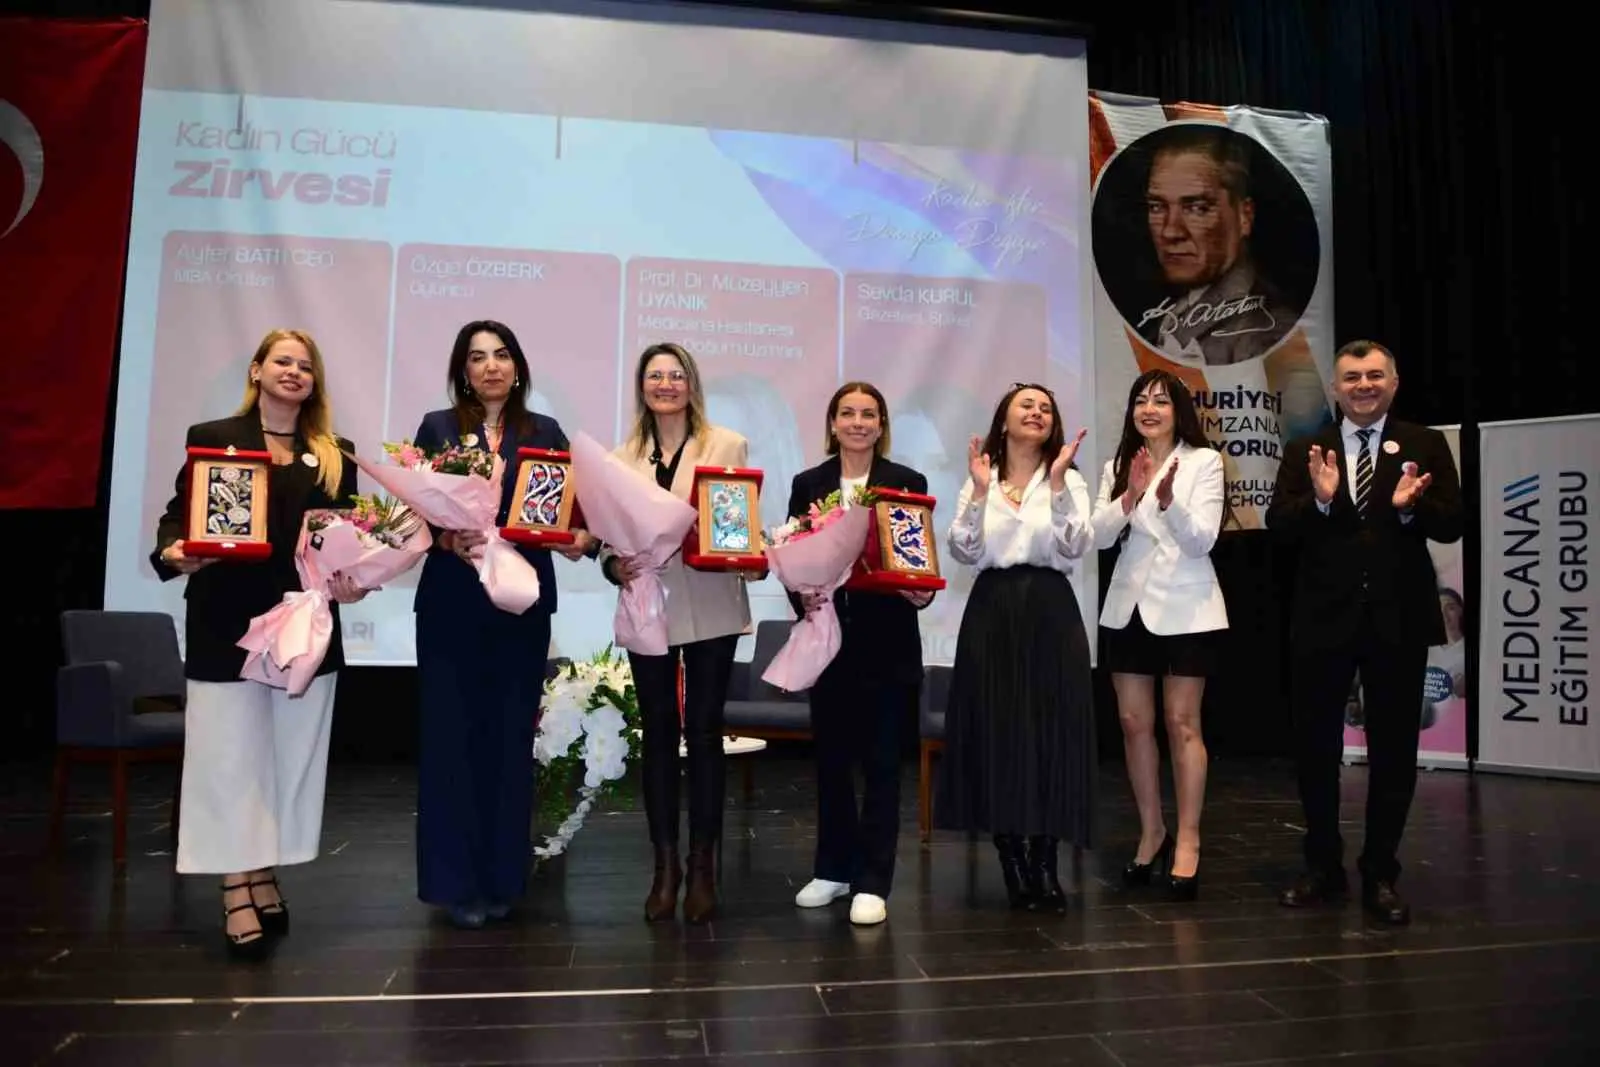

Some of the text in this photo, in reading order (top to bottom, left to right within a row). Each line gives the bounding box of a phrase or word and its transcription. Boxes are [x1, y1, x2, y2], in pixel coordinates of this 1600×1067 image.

[175, 119, 397, 160] Kadın Gücü
[168, 158, 392, 208] Zirvesi
[465, 257, 545, 281] ÖZBERK
[857, 282, 976, 308] Sevda KURUL
[1502, 498, 1541, 721] MEDICANA
[1550, 470, 1588, 726] EĞİTİM GRUBU
